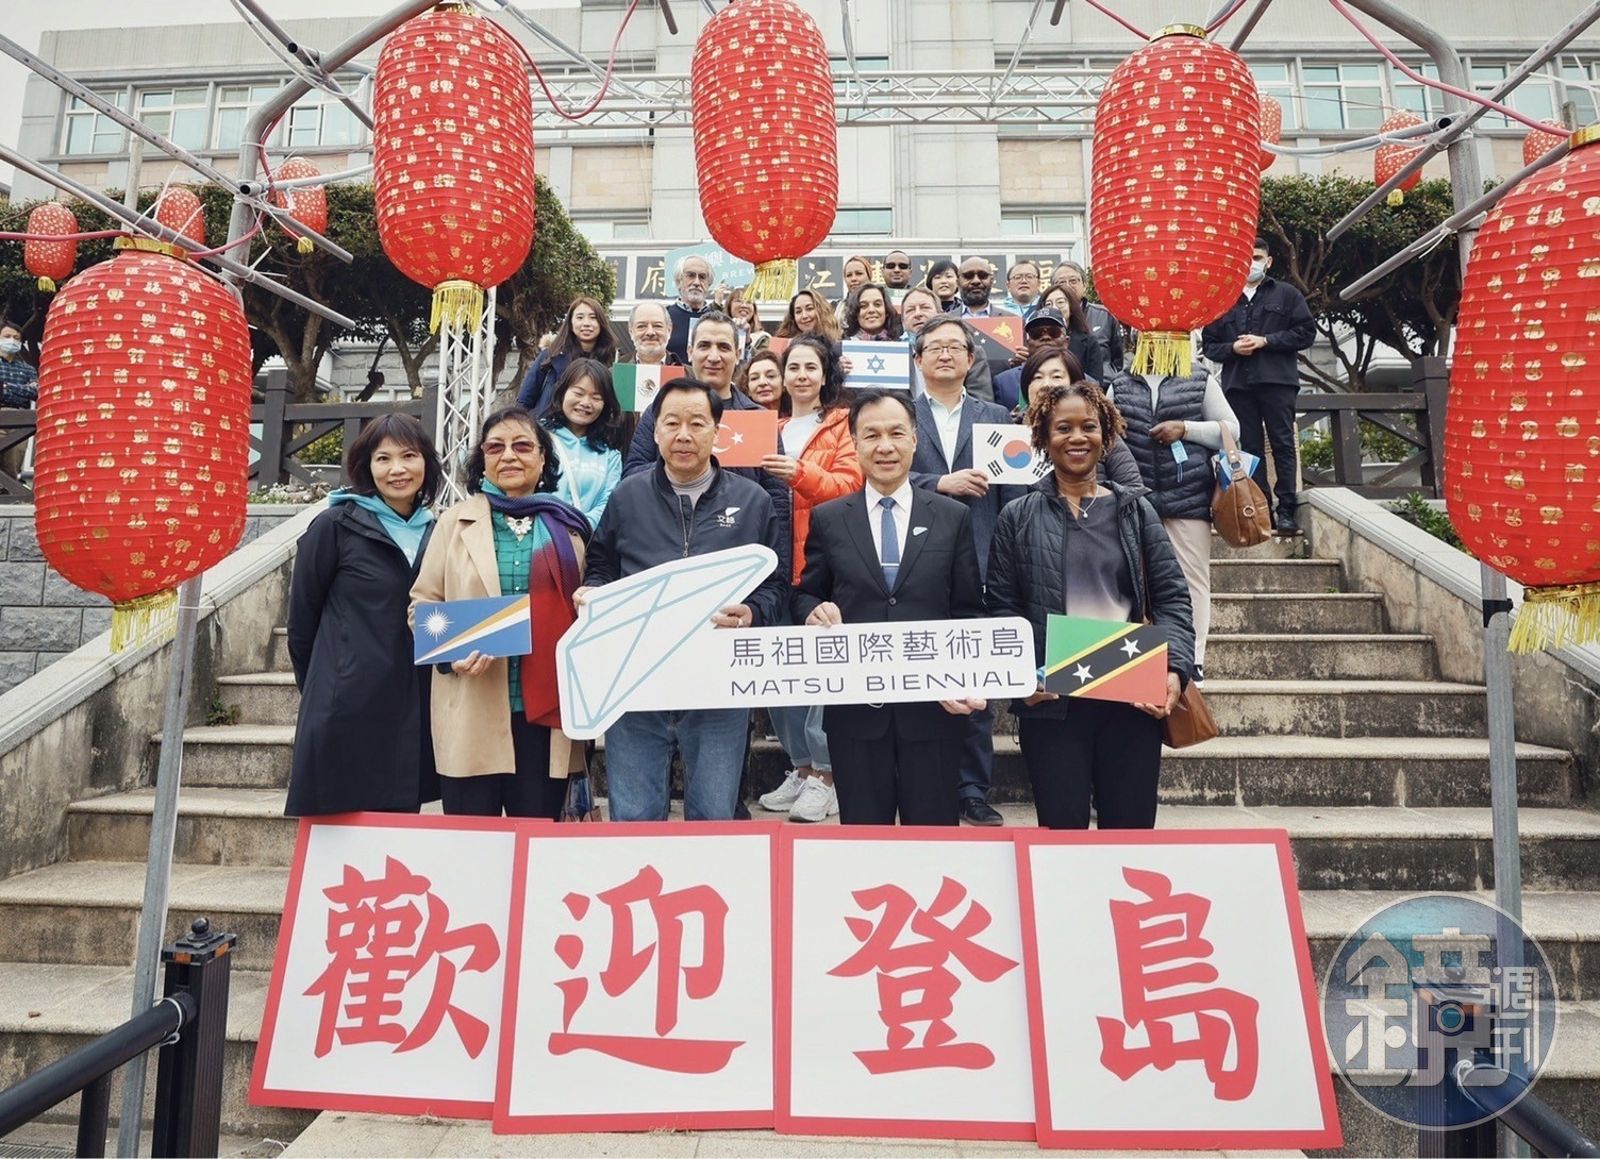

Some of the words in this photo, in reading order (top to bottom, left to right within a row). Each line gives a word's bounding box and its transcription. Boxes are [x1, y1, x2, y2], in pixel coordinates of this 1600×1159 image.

[730, 629, 1025, 668] 馬祖國際藝術島
[731, 678, 845, 697] MATSU
[866, 670, 1026, 692] BIENNIAL
[304, 856, 1261, 1102] 歡迎登島
